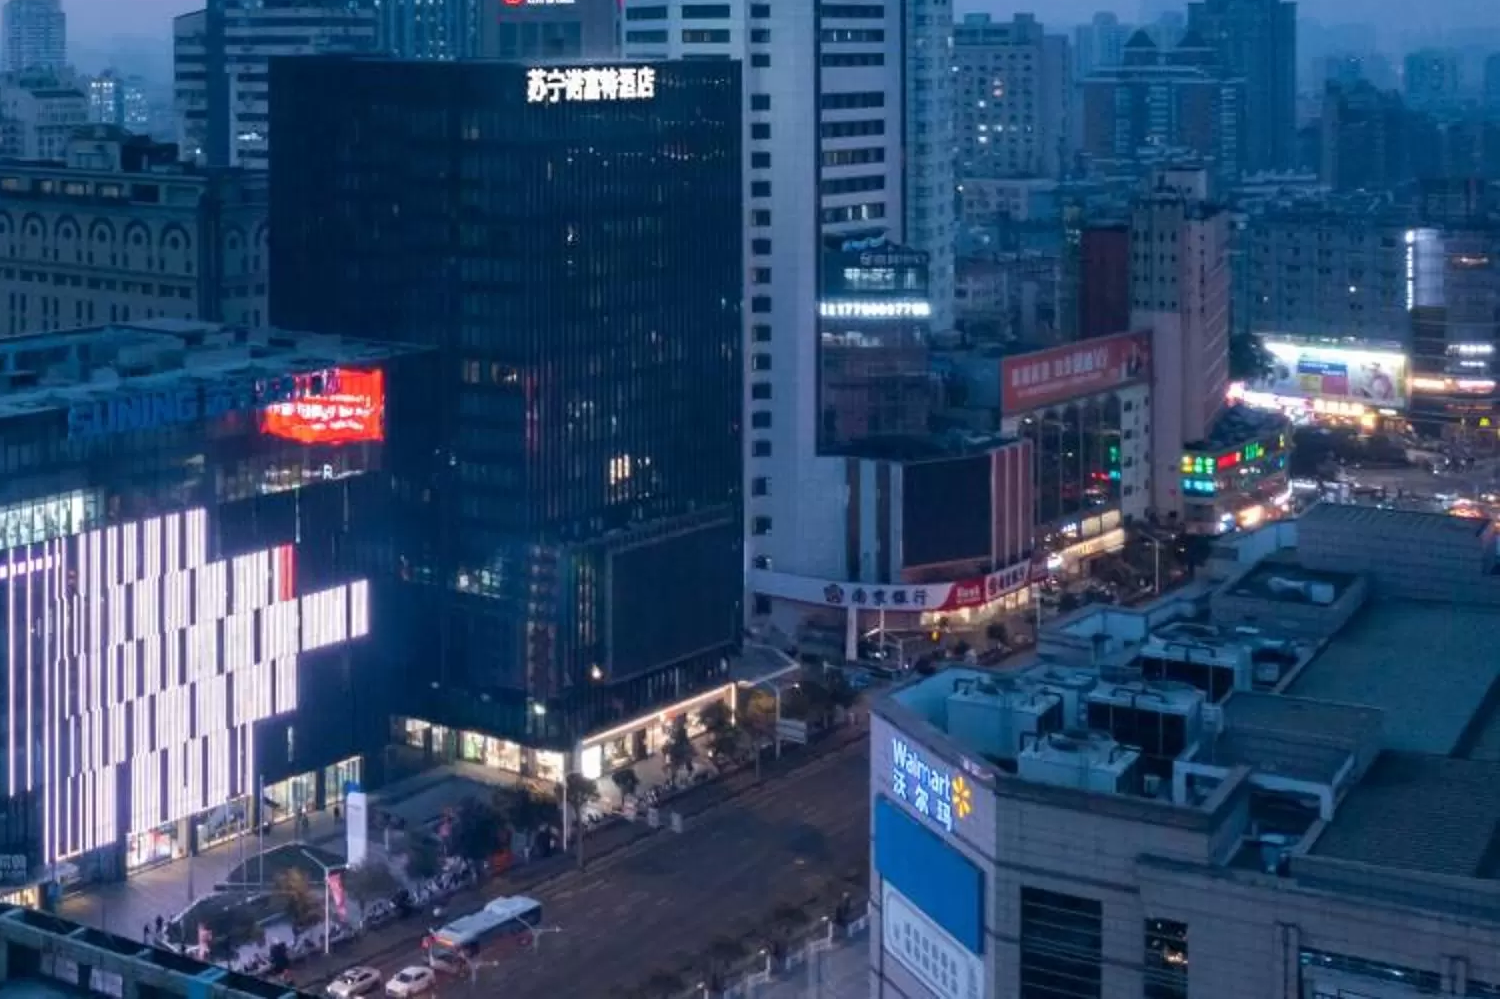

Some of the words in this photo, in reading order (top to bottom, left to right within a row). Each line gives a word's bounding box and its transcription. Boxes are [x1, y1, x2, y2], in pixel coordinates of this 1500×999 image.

[892, 737, 951, 802] Walmart
[893, 767, 952, 833] 沃尔玛
